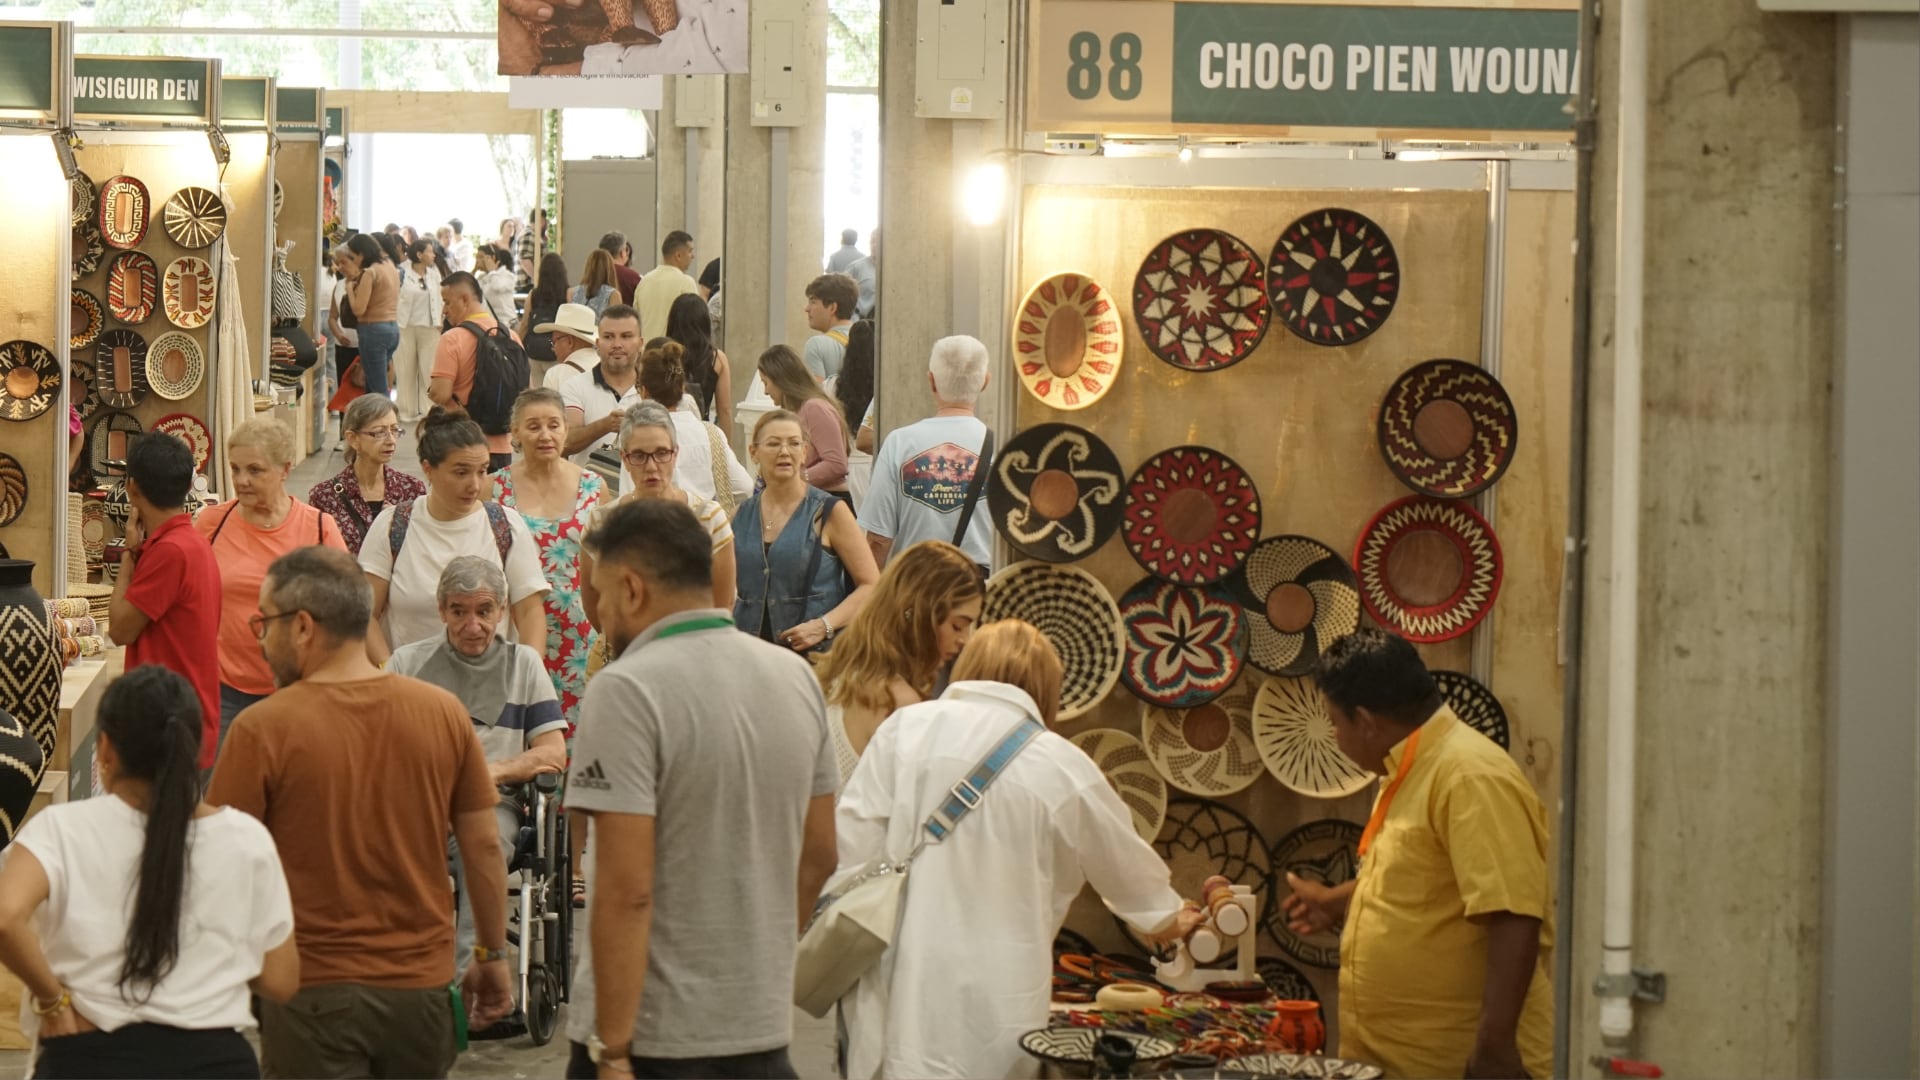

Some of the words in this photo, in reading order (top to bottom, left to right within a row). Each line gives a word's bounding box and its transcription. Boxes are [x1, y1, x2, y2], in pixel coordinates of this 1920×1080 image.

[1066, 31, 1143, 100] 88
[1200, 41, 1334, 91] CHOCO
[1346, 45, 1437, 92] PIEN
[74, 76, 158, 100] WISIGUIR
[163, 79, 199, 101] DEN
[775, 104, 782, 112] 6
